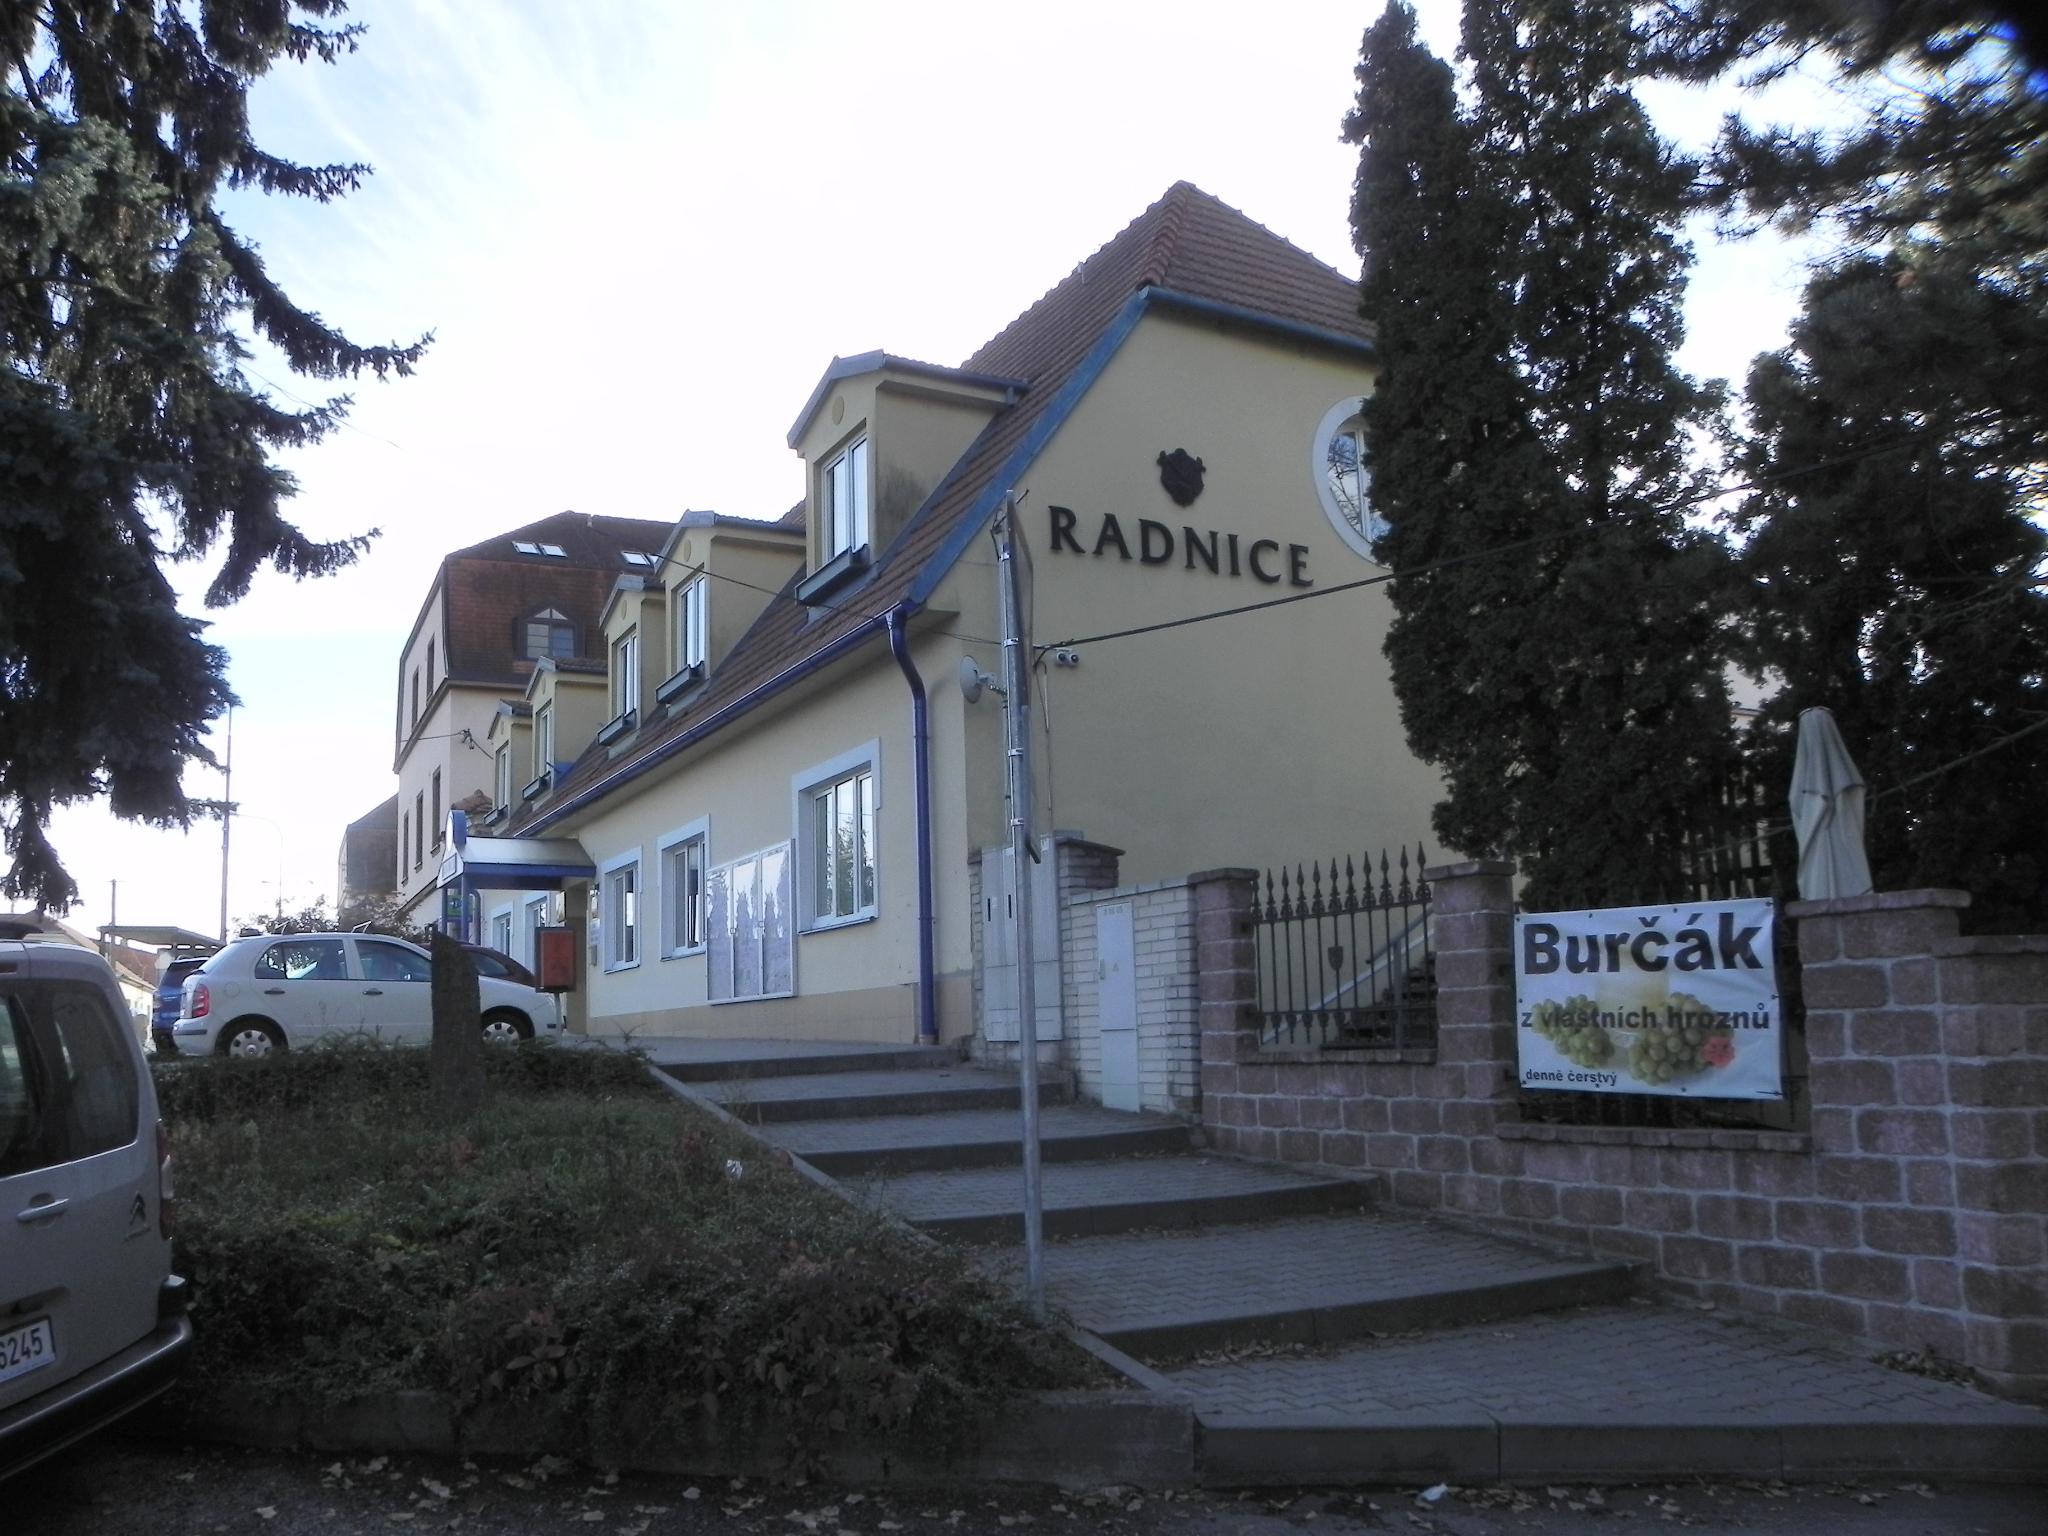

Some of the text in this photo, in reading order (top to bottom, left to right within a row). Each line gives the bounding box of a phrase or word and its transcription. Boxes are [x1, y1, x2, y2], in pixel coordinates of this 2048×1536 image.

[1048, 505, 1313, 586] RADNICE
[1523, 912, 1764, 975] Burčák
[1521, 1003, 1769, 1030] z vlastních hroznů
[1525, 1068, 1617, 1087] denně čerstvý
